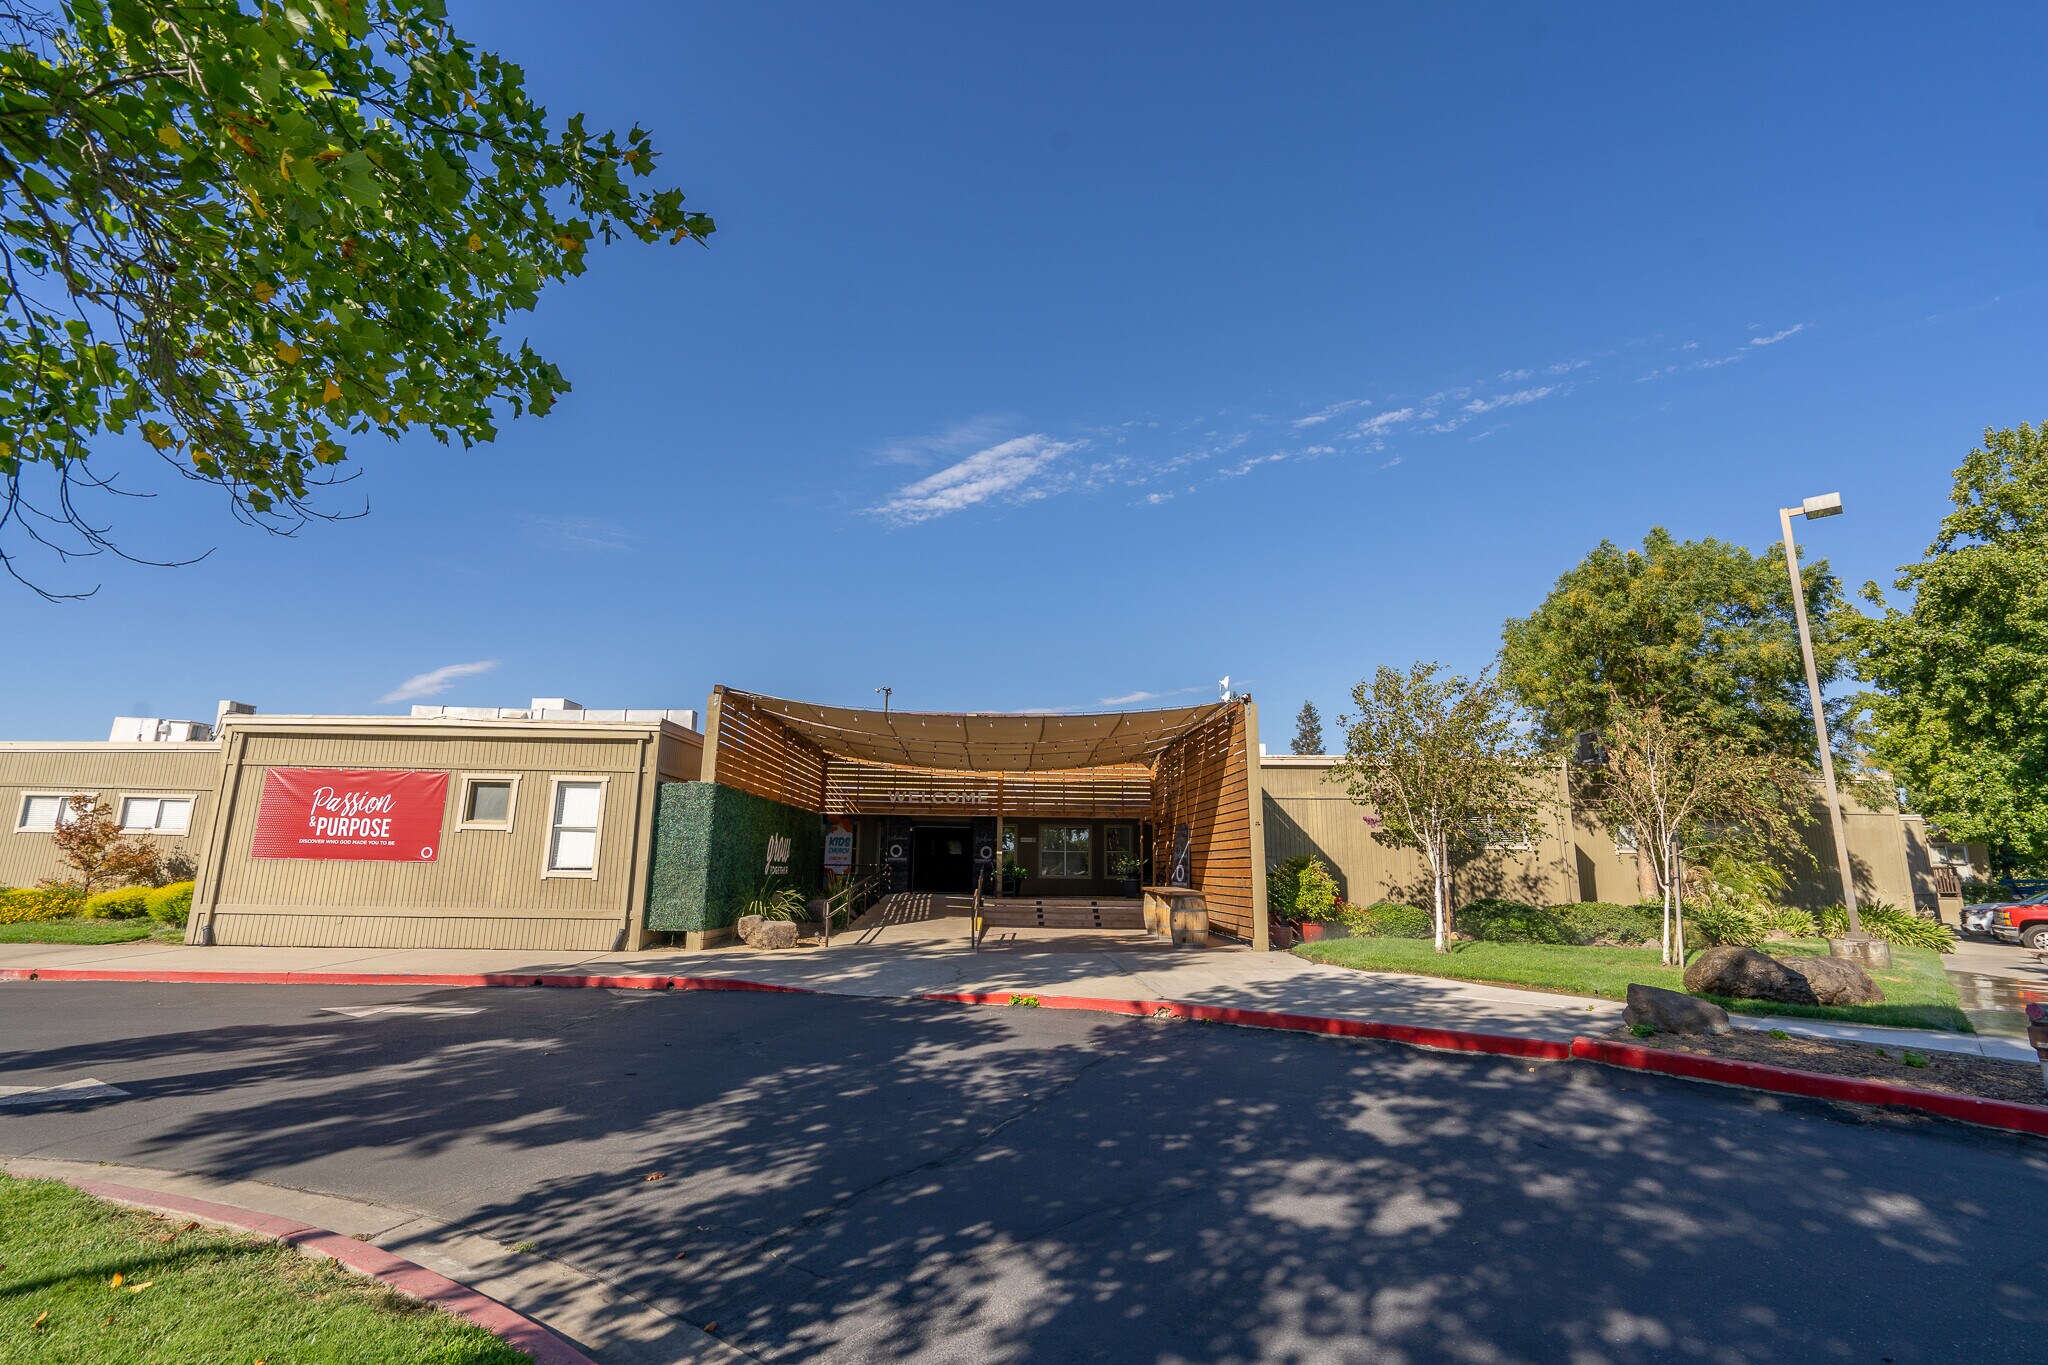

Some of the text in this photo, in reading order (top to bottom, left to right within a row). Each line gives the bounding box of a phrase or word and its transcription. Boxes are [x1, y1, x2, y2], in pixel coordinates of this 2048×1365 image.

[310, 786, 396, 816] Passion
[888, 791, 989, 805] WELCOME
[316, 817, 392, 838] PURPOSE
[829, 837, 850, 847] KIDS
